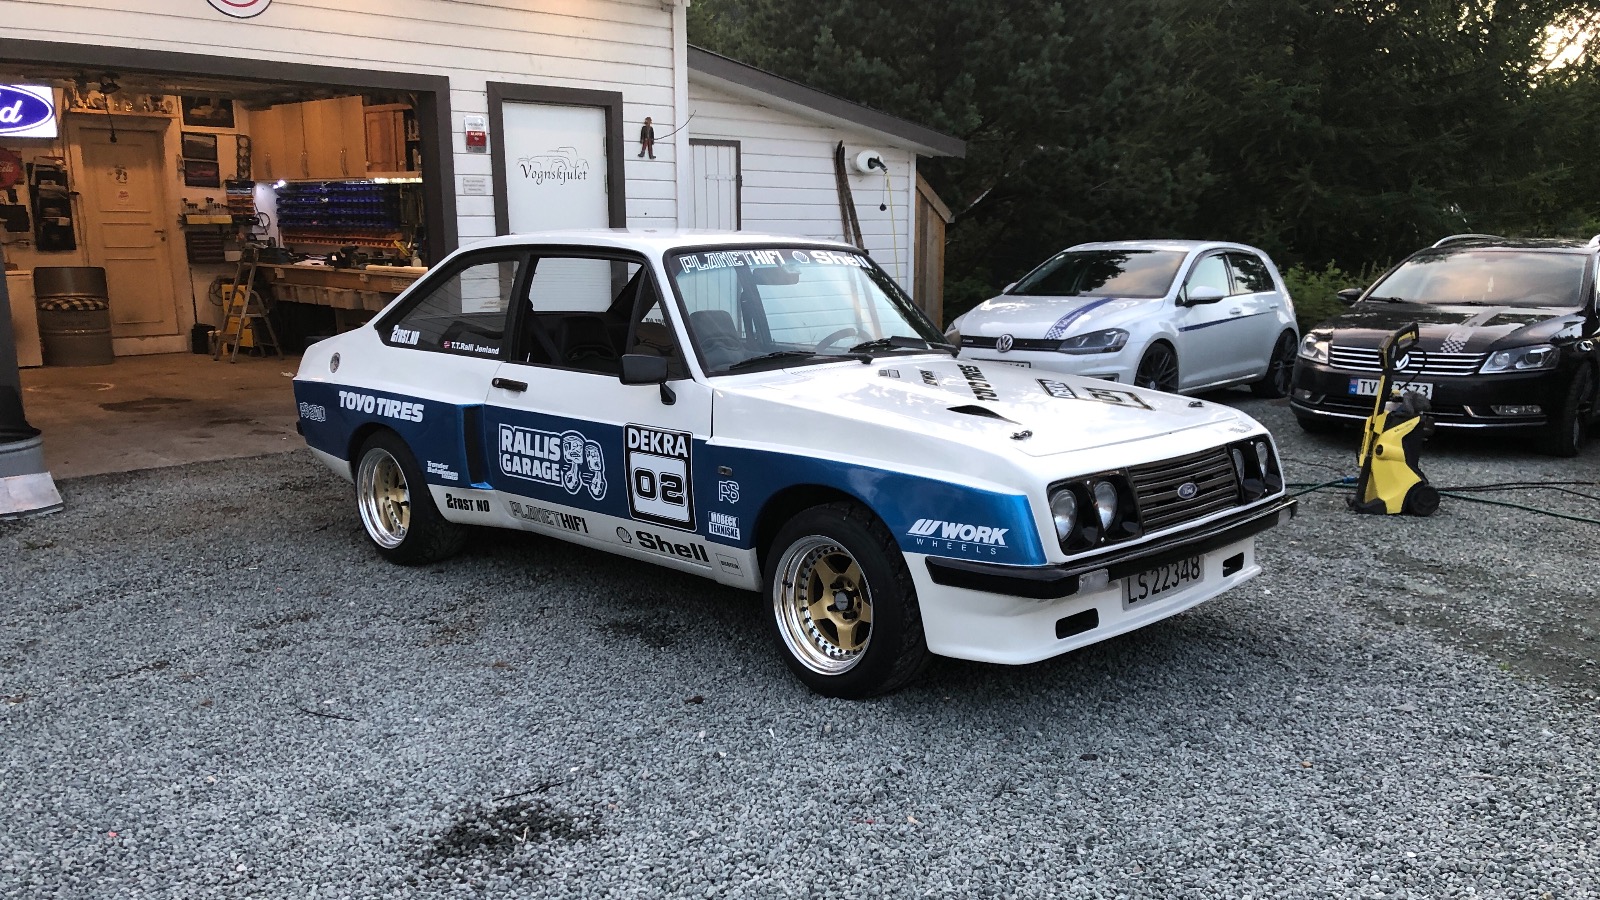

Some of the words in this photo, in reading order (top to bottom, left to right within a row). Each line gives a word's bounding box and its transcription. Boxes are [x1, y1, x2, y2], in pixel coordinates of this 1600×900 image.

[520, 164, 587, 185] Vognskjulet
[810, 250, 873, 270] Shell
[1361, 381, 1378, 394] TV
[339, 391, 375, 414] TOYO
[377, 398, 425, 423] TIRES
[501, 428, 561, 462] RALLIS
[628, 427, 689, 458] DEKRA
[502, 453, 560, 482] GARAGE
[633, 467, 686, 507] 02
[476, 499, 490, 512] NO
[636, 530, 710, 563] Shell
[916, 537, 997, 555] WHEELS
[941, 521, 1009, 546] WORK
